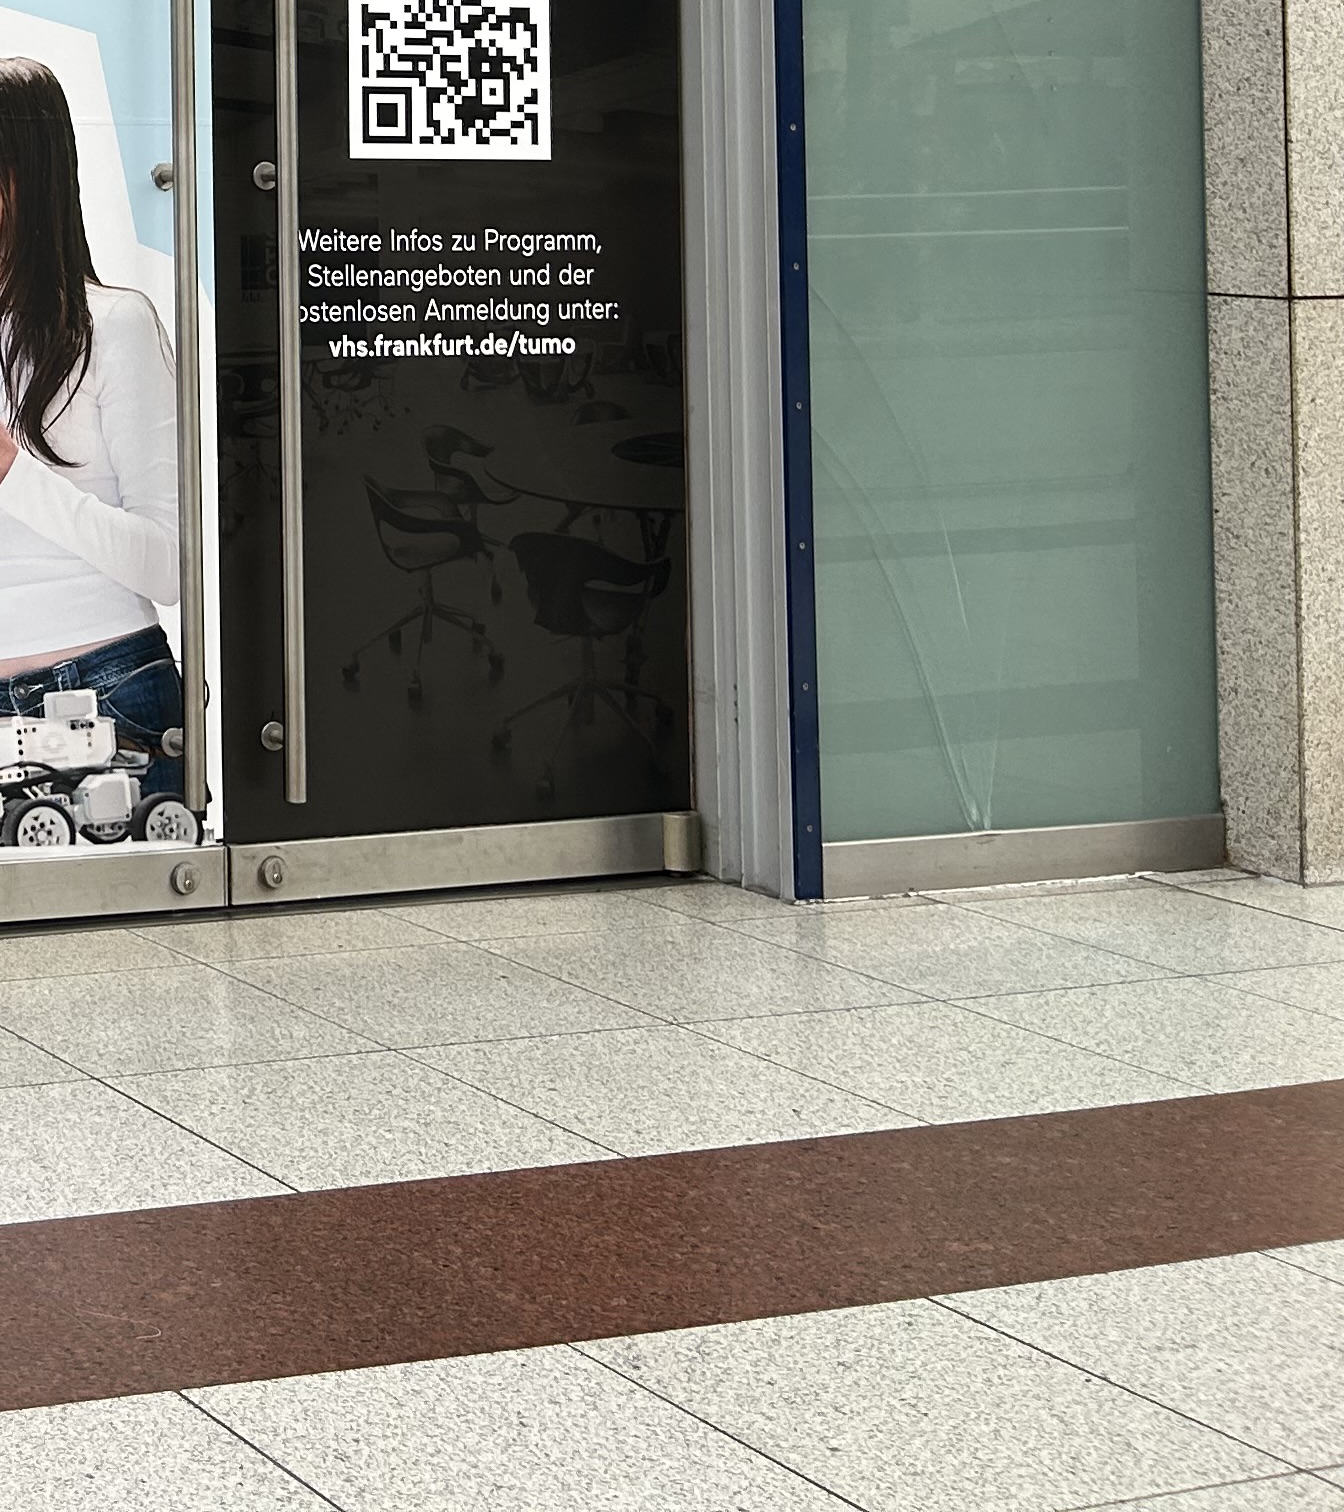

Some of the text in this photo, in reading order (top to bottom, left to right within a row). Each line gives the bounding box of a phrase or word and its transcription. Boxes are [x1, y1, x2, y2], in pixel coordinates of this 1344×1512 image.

[298, 228, 602, 258] Weitere Infos zu Programm,
[308, 262, 595, 292] Stellenangeboten und der
[299, 297, 619, 326] ostenlosen Anmeldung unter:
[328, 330, 576, 358] vhs.frankfurt.de/tumo
